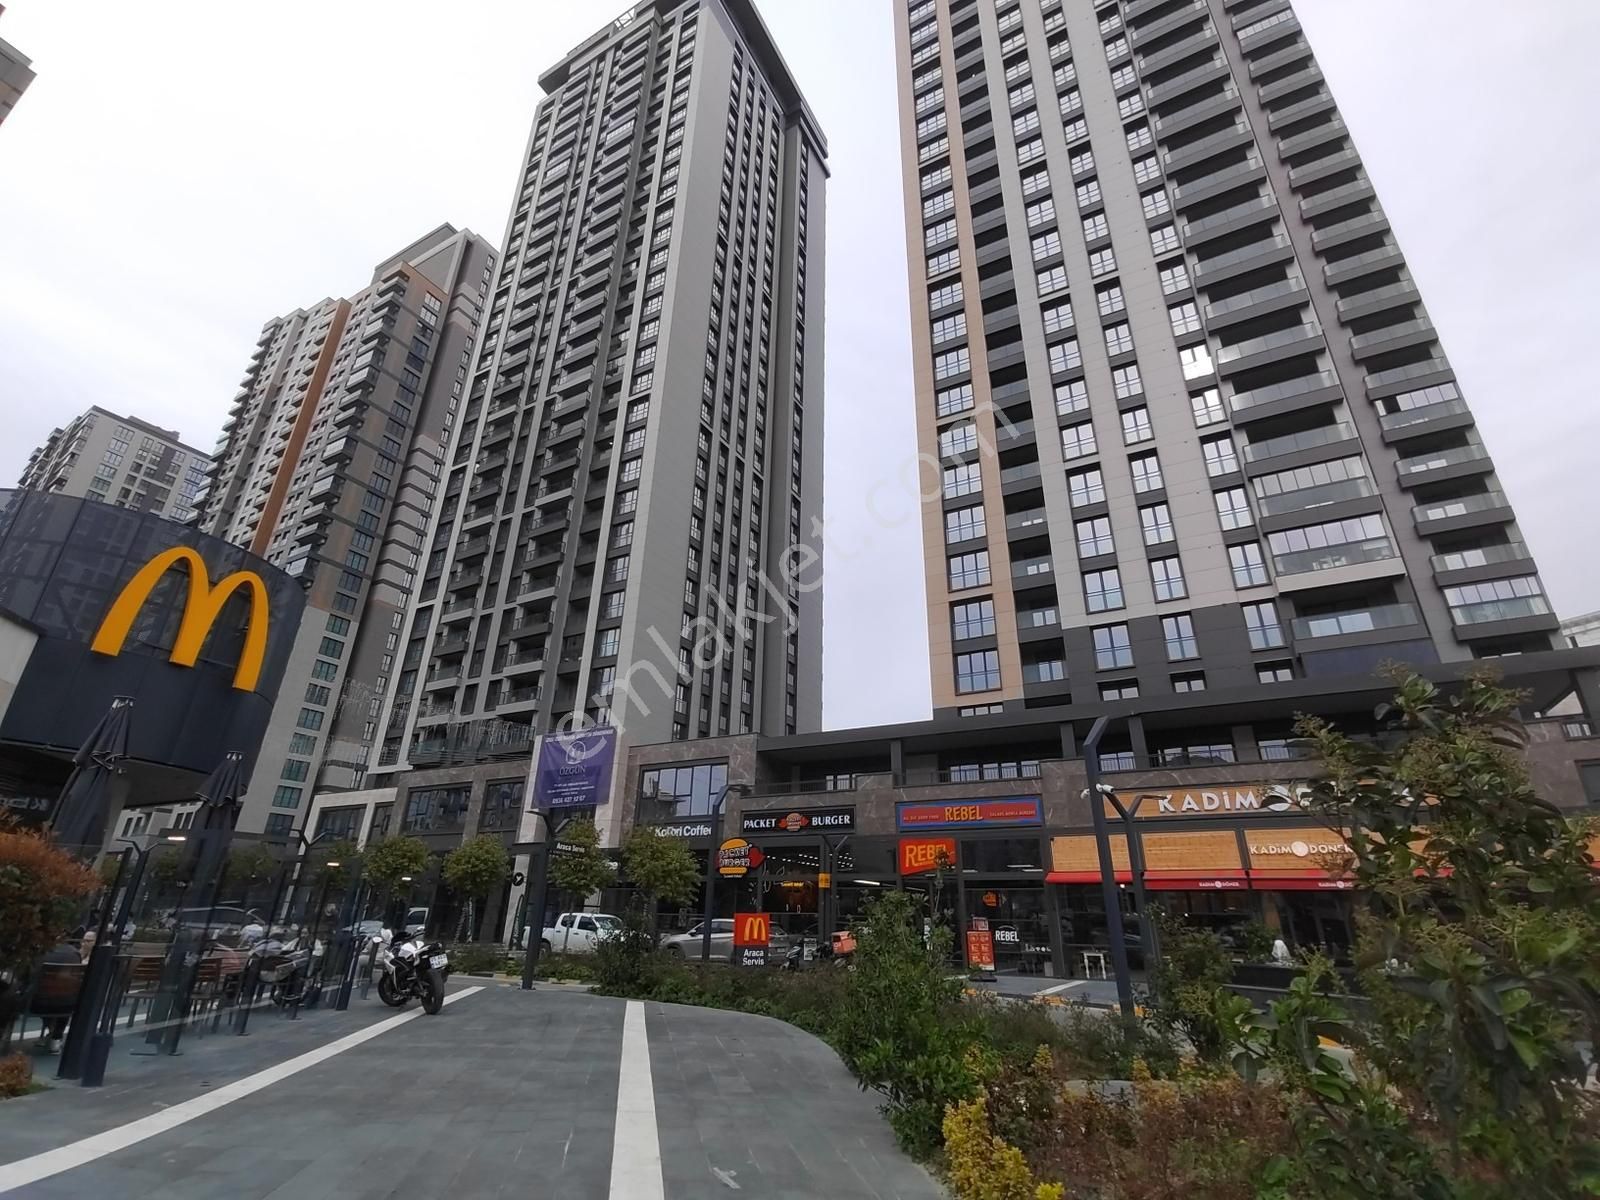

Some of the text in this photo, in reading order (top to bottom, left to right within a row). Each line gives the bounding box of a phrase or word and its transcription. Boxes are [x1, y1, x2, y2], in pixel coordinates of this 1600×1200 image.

[944, 804, 984, 821] REBEL
[743, 818, 777, 829] PACKET
[811, 814, 851, 826] BURGER
[994, 930, 1020, 942] REBEL
[743, 949, 765, 957] Araca
[742, 957, 765, 966] Servis
